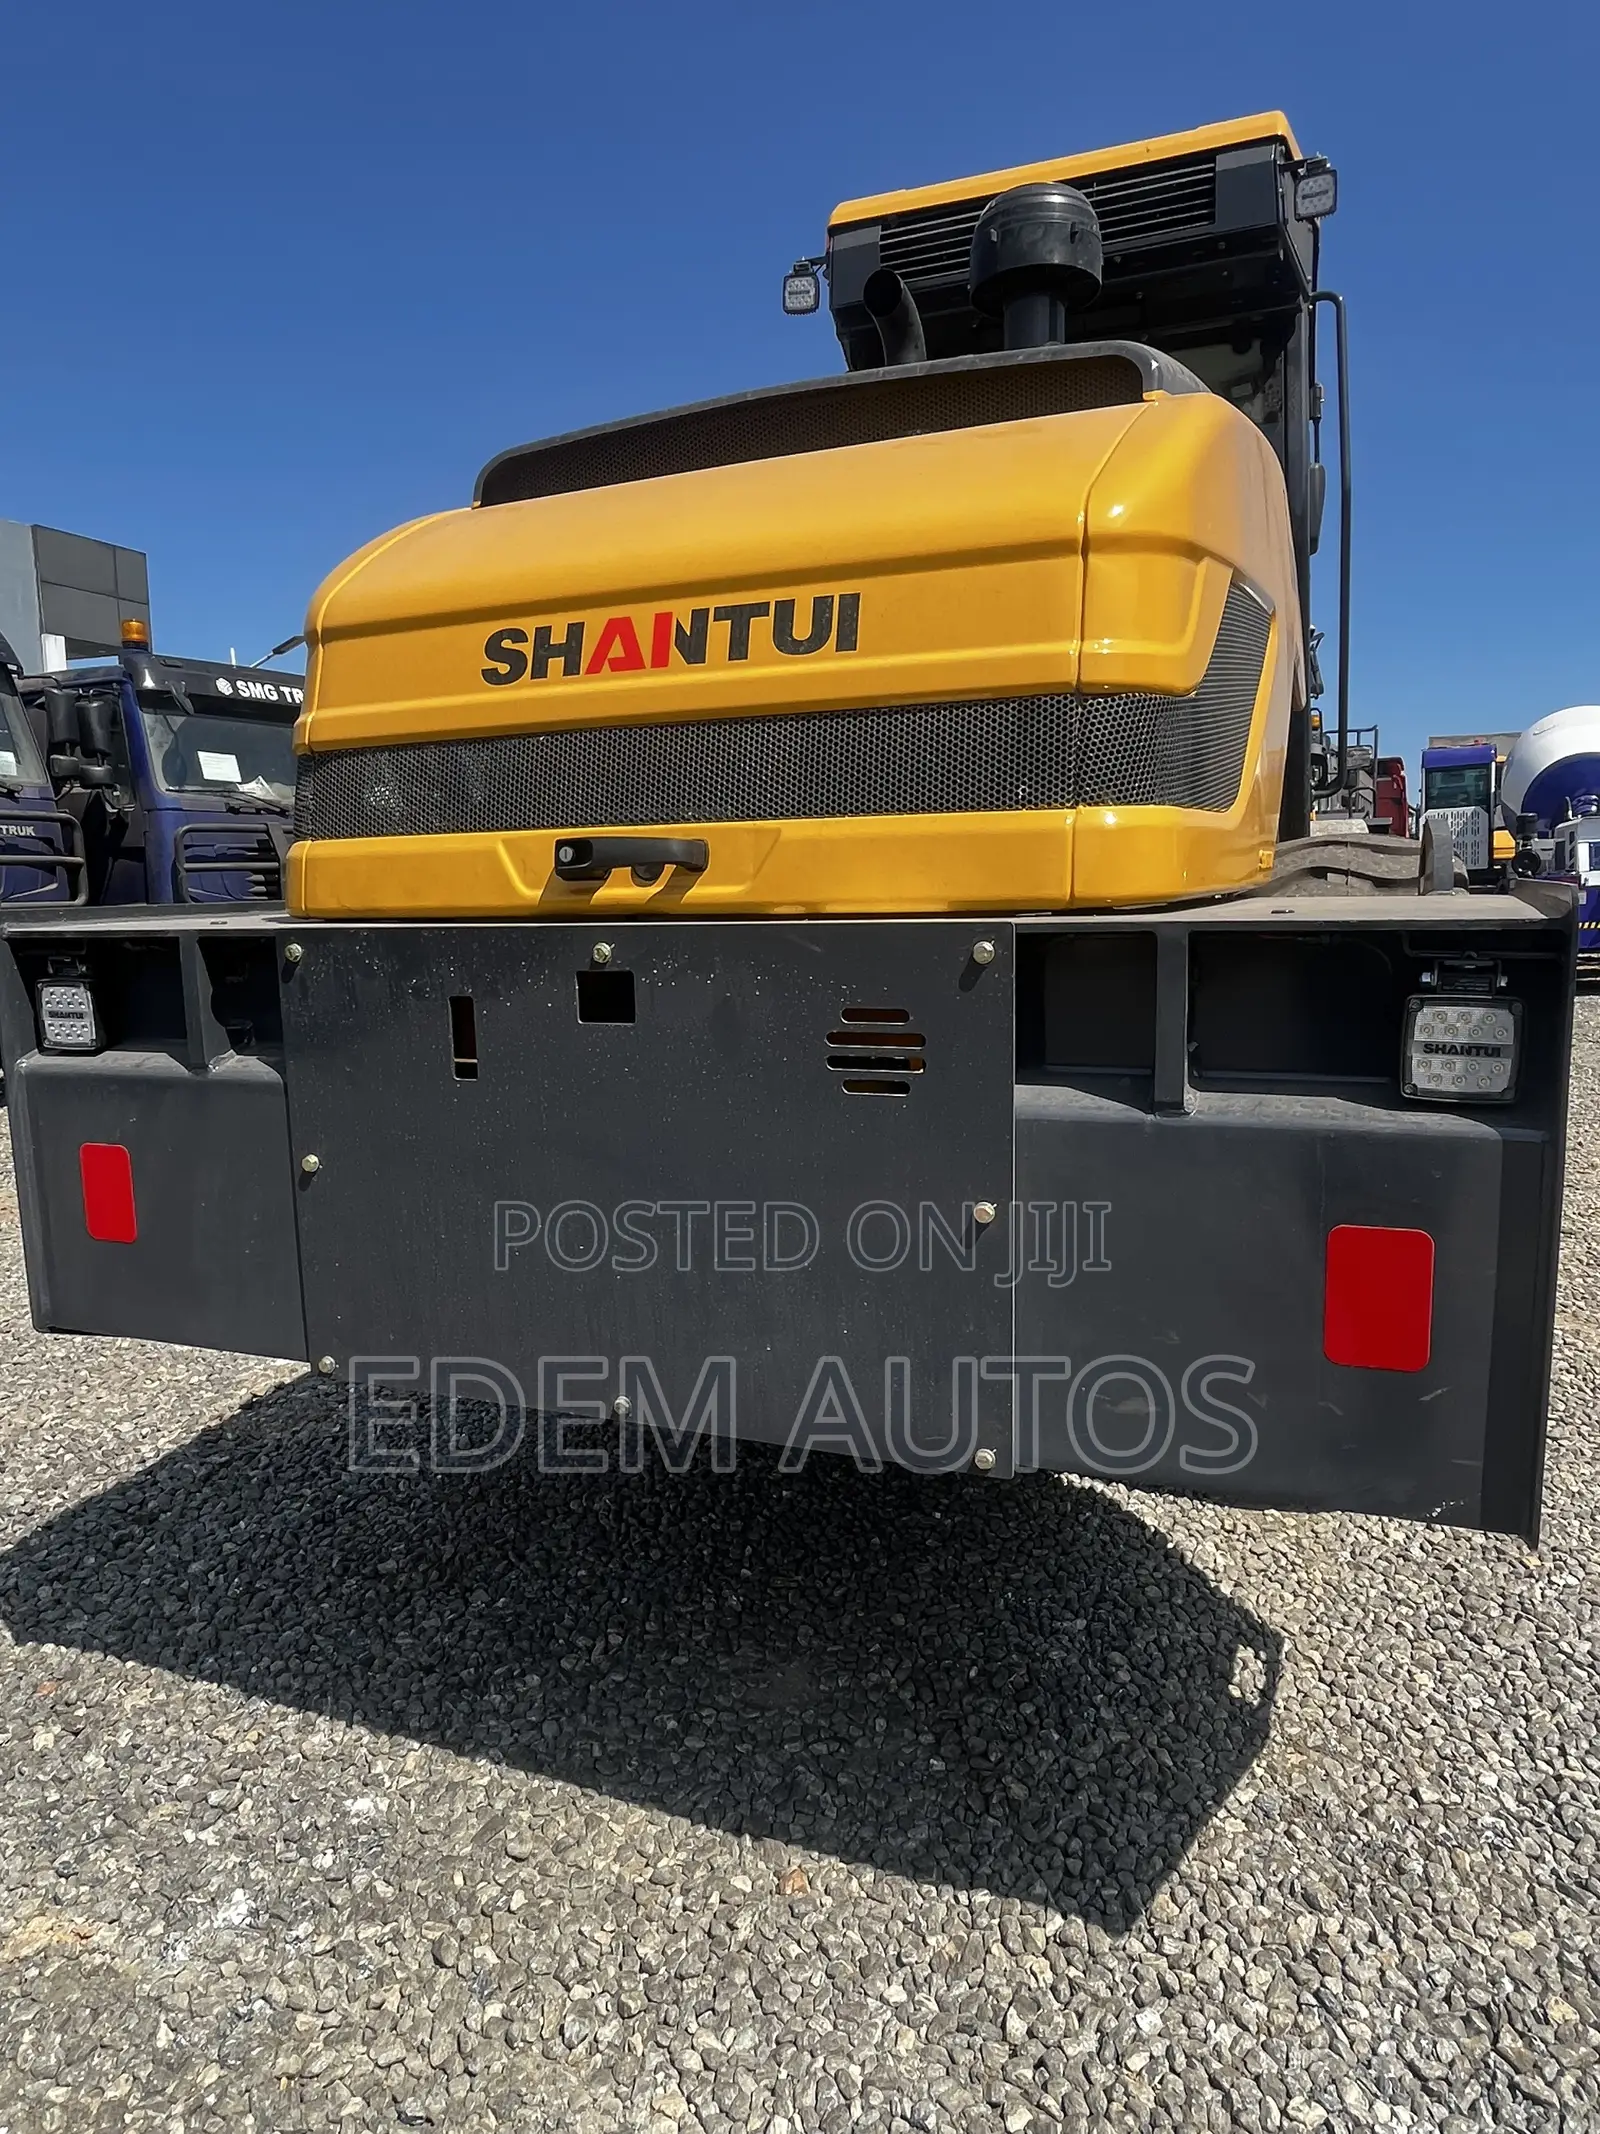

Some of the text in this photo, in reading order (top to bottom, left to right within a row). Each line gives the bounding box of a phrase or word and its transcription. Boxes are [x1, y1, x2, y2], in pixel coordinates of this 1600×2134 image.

[481, 592, 861, 685] SHANTUI
[235, 680, 304, 704] SMG TR
[0, 825, 36, 836] TRUK
[1423, 1043, 1502, 1057] SHANTUI
